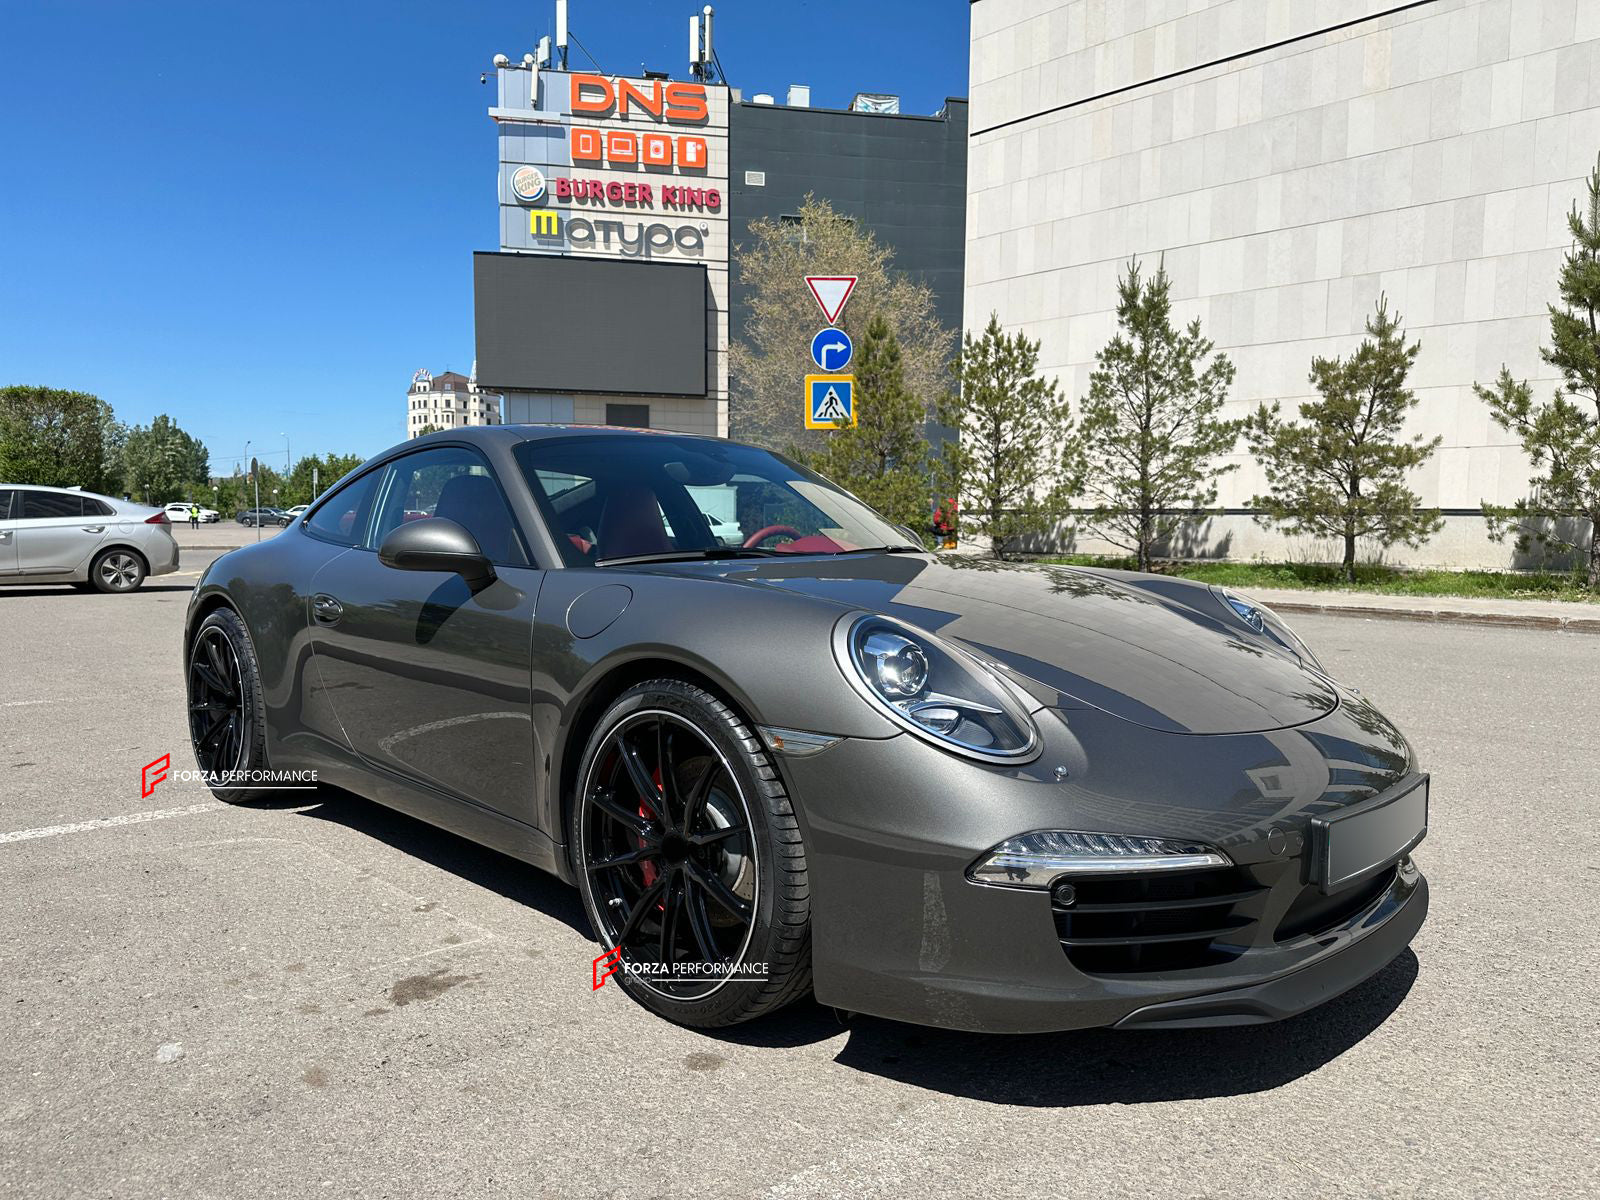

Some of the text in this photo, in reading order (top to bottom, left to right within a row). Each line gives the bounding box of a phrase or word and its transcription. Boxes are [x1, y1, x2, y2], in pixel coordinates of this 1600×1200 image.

[570, 73, 708, 120] DNS
[515, 171, 539, 186] BURGER
[517, 177, 541, 193] KING
[556, 177, 721, 207] BURGER KING
